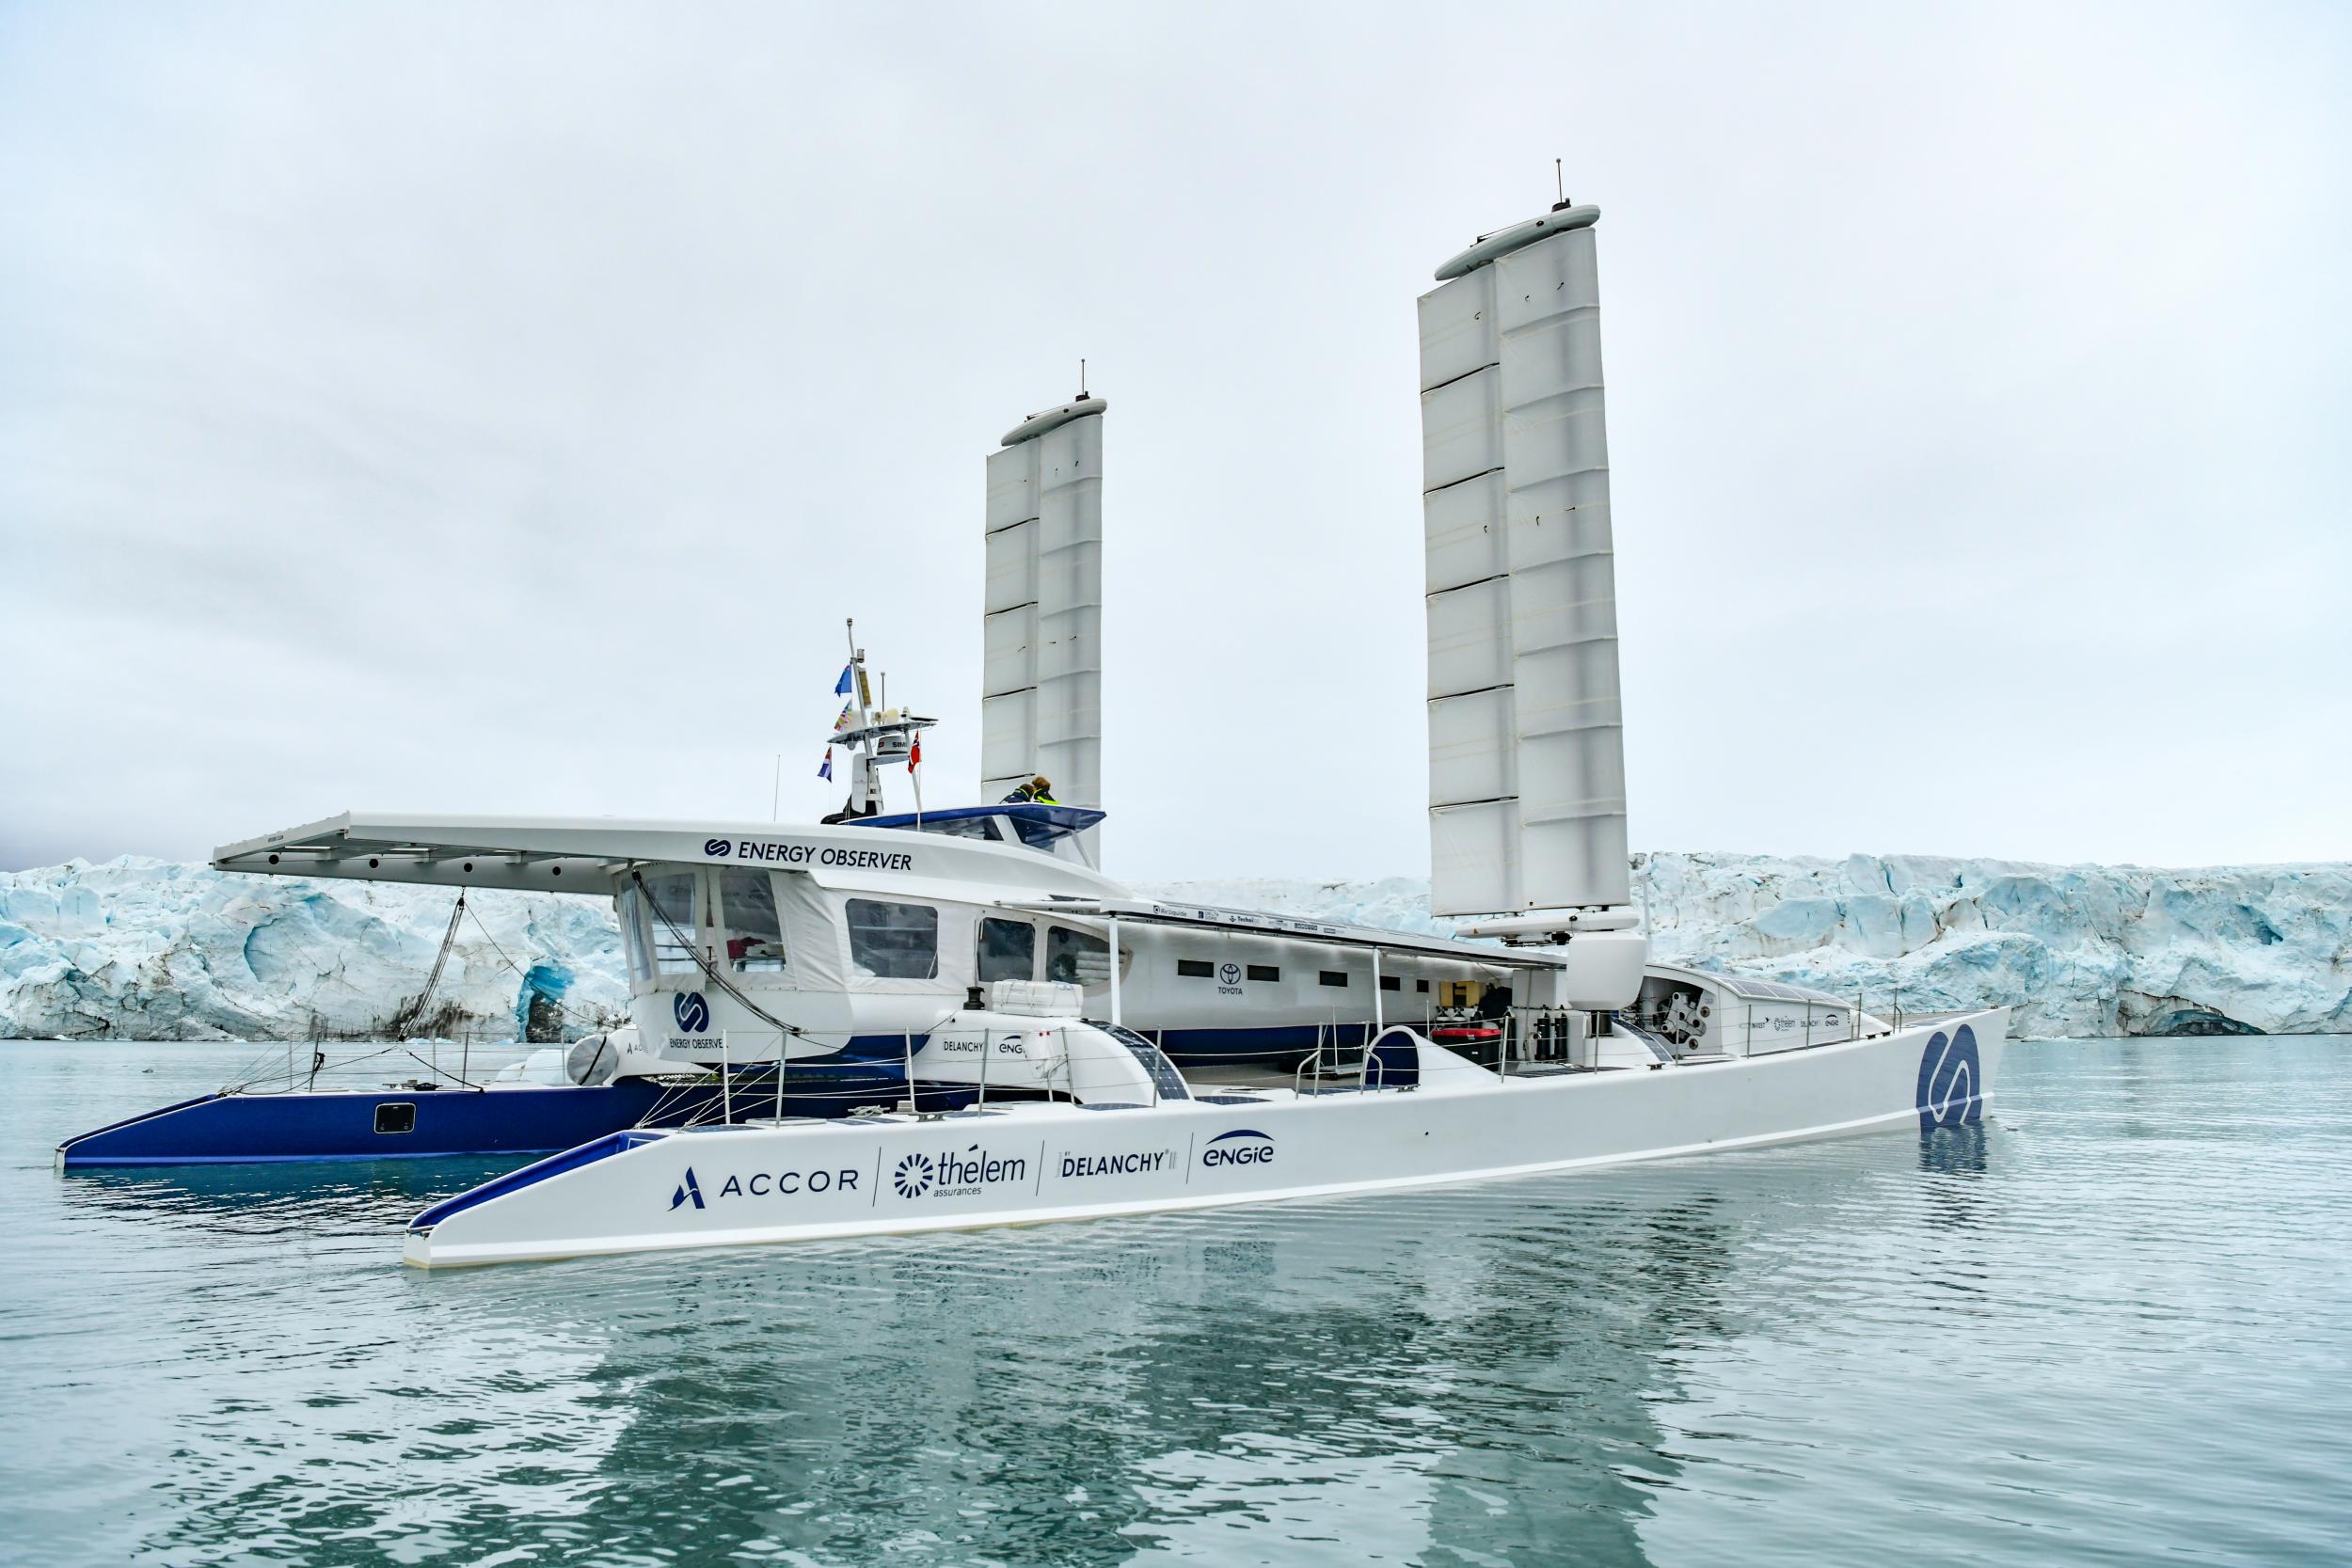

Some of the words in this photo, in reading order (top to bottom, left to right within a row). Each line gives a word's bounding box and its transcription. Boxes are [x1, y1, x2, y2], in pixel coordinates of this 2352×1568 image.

[739, 841, 816, 863] ENERGY
[820, 847, 913, 870] OBSERVER
[1217, 986, 1243, 995] TOYOTA
[669, 1037, 691, 1049] ENERGY
[691, 1037, 728, 1049] OBSERVE
[944, 1040, 984, 1053] DELANCHY
[938, 1144, 1025, 1185] thélem
[1061, 1153, 1165, 1178] DELANCHY
[720, 1169, 859, 1197] ACCOR
[933, 1186, 982, 1197] assurances
